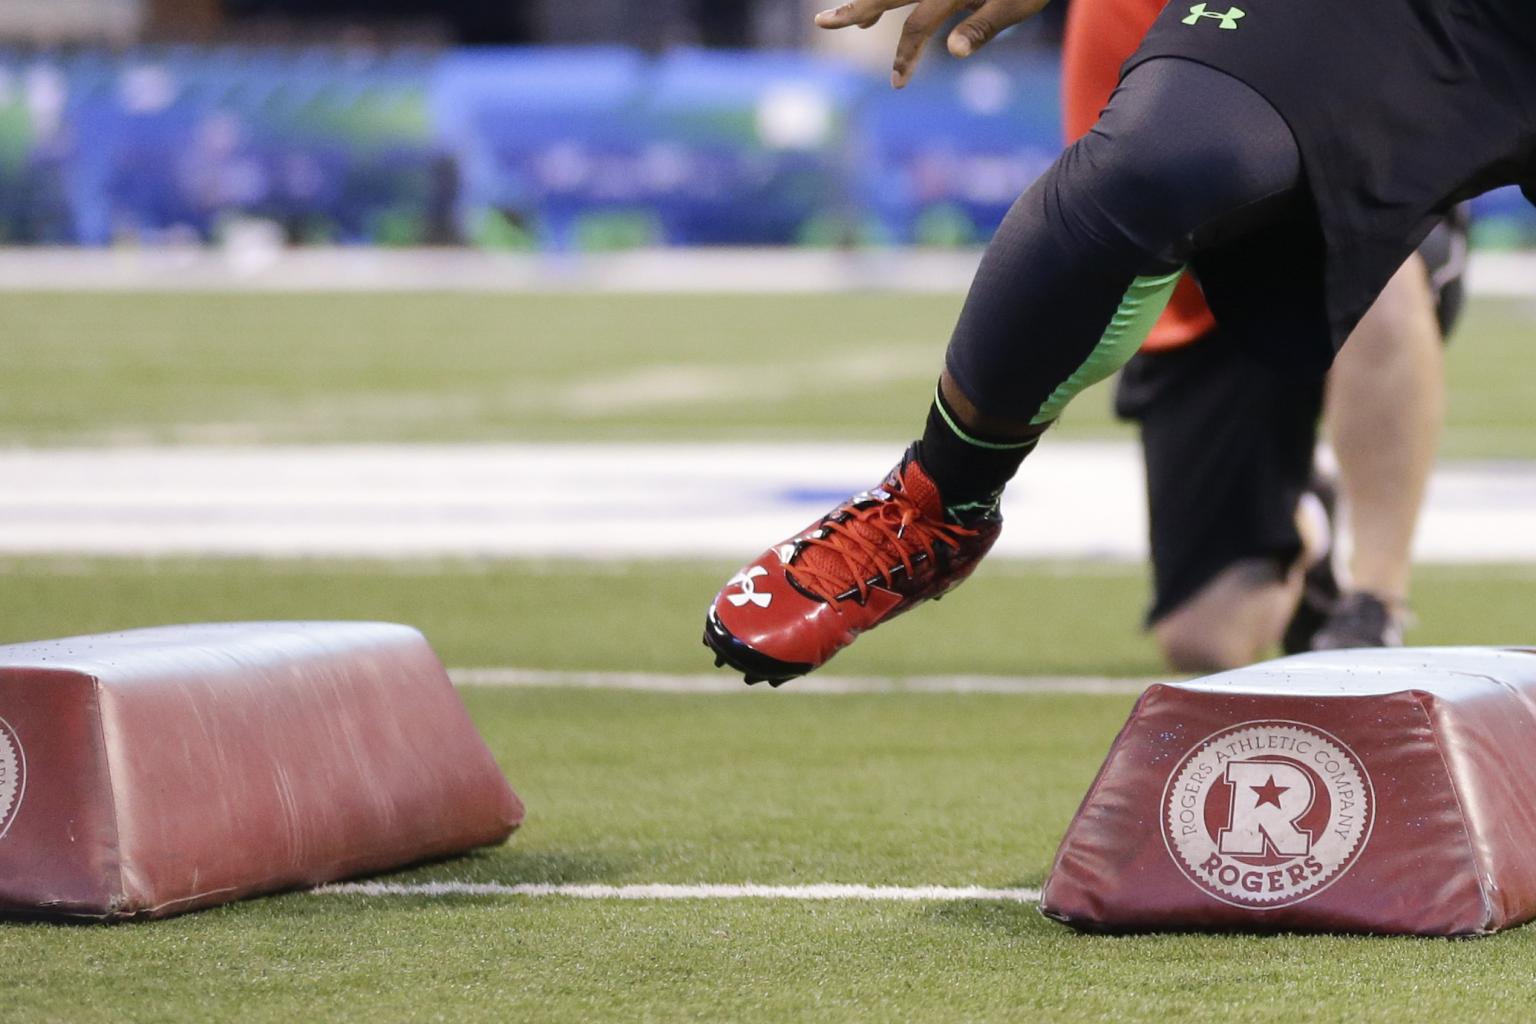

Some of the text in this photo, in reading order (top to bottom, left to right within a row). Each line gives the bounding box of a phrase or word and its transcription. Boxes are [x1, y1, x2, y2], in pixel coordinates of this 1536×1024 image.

[1180, 736, 1354, 841] ROGERS ATHLETIC COMPANY
[1217, 760, 1316, 857] R
[1200, 852, 1323, 893] ROGERS
